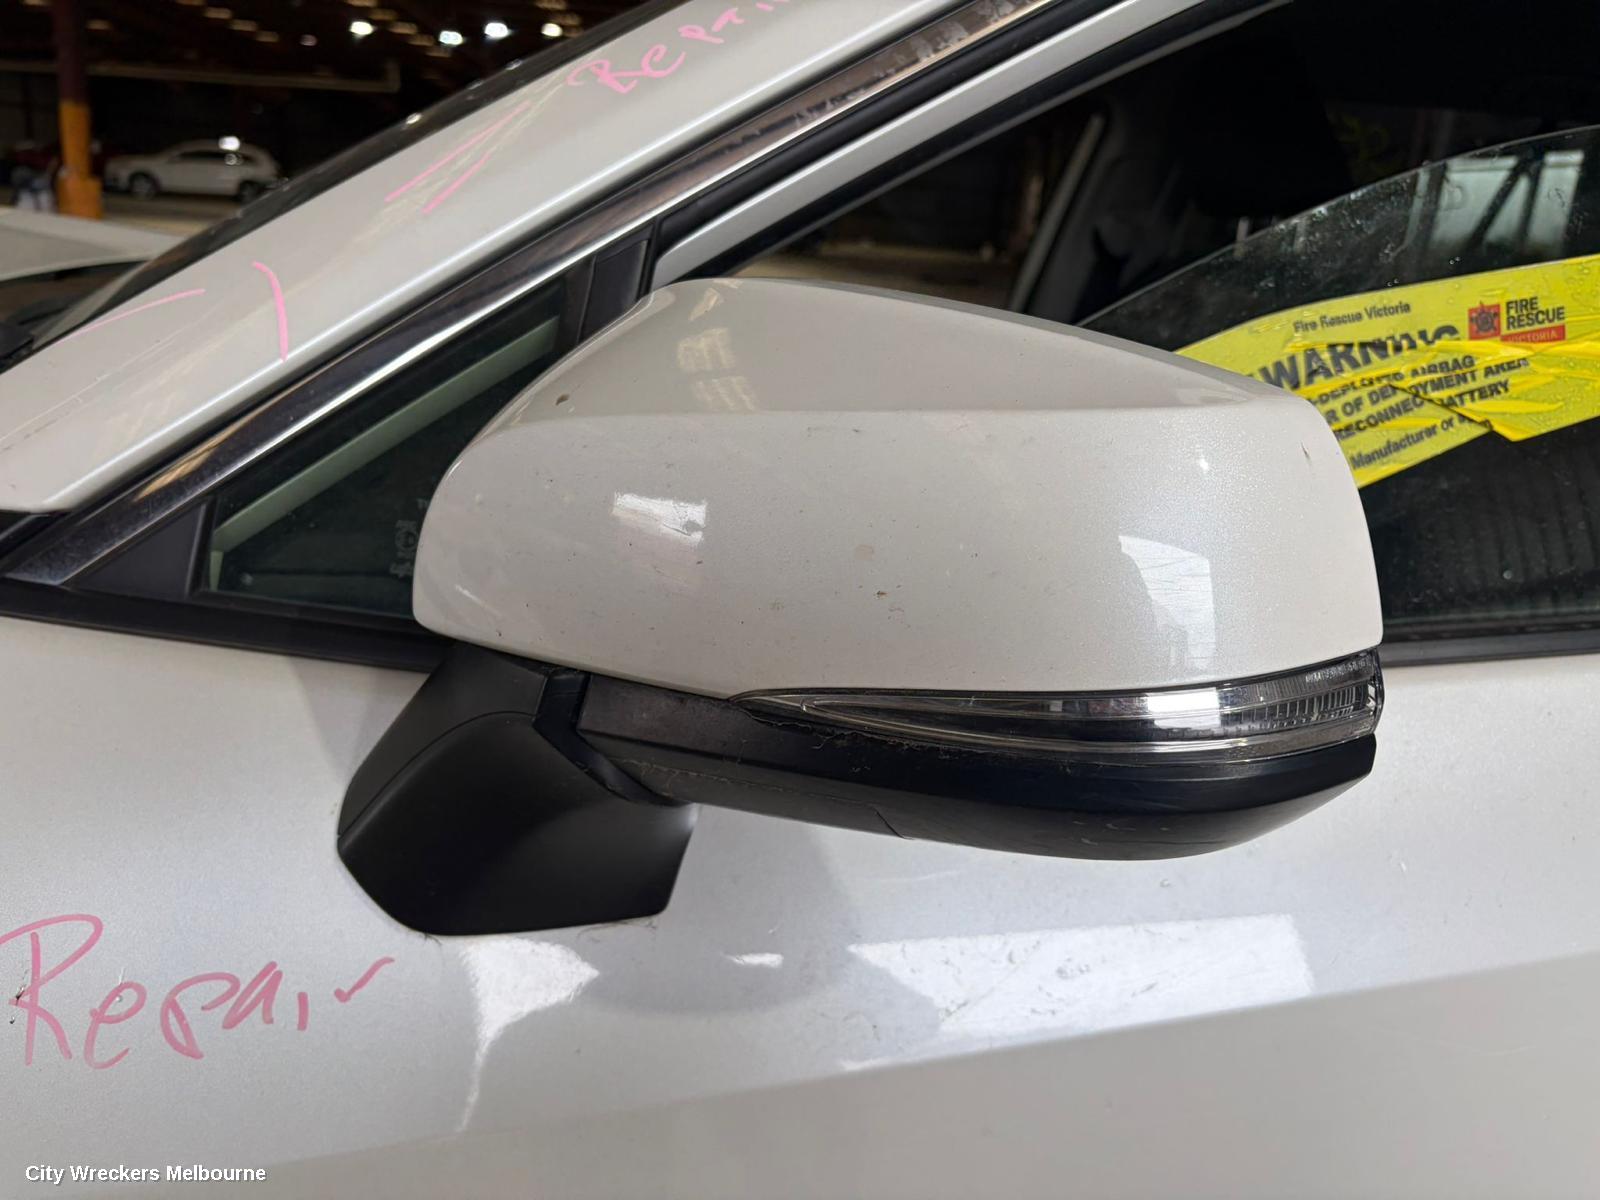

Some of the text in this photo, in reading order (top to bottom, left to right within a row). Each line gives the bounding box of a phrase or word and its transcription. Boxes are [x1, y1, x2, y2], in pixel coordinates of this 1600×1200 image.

[1293, 301, 1411, 333] Fire Rescue Victoria
[1506, 296, 1539, 315] FIRE
[1506, 306, 1565, 331] RESCUE
[1411, 355, 1475, 377] AIRBAG
[1440, 379, 1509, 407] ATTERY
[1342, 396, 1364, 417] OF
[1351, 416, 1454, 469] Manufacturer or
